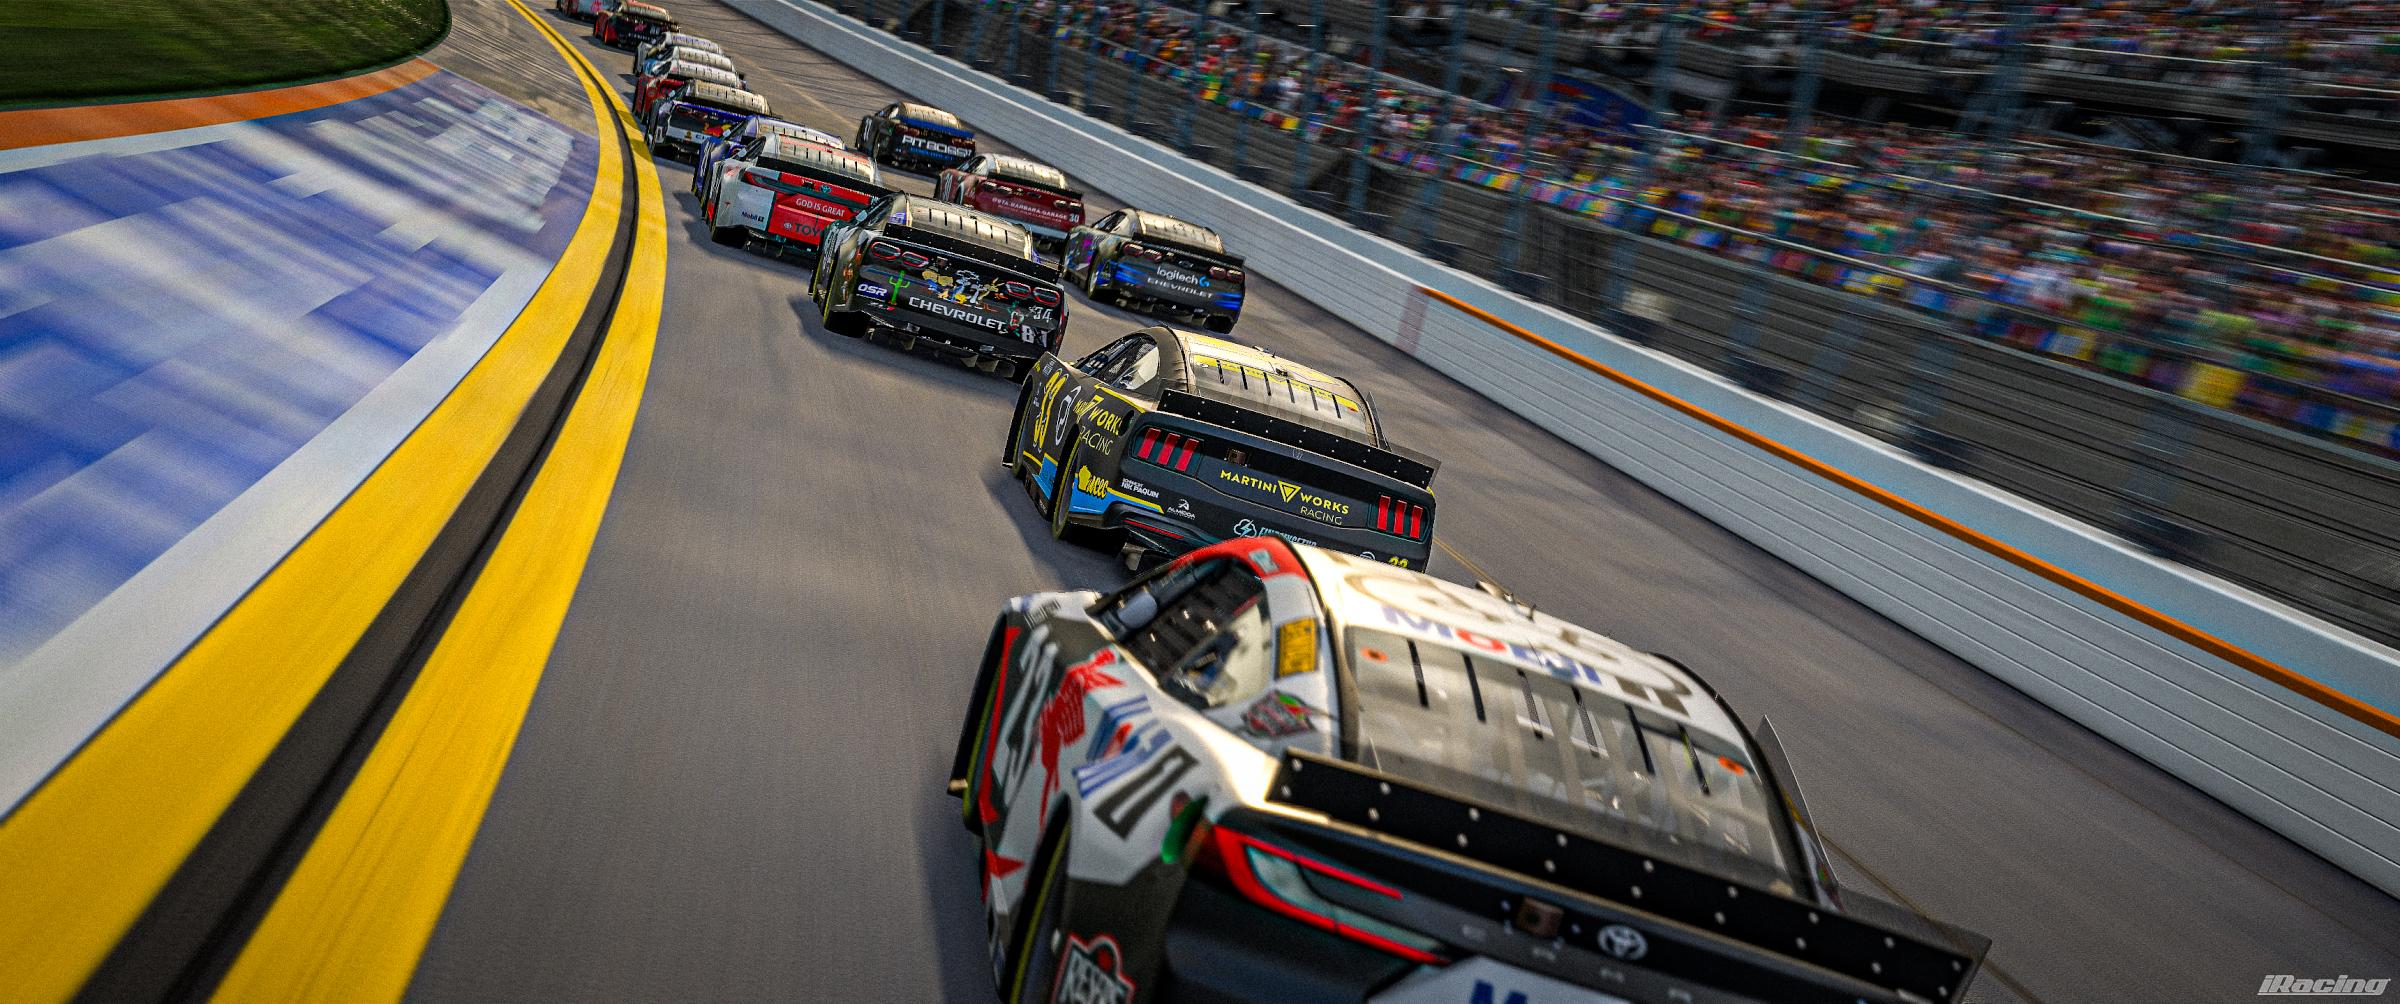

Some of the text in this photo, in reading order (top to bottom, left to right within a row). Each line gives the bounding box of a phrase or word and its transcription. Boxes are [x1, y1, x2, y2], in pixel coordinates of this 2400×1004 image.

[901, 135, 926, 147] PIT
[926, 141, 968, 158] BOSS
[742, 211, 758, 222] Mobil
[796, 198, 846, 217] GOD IS GREAT
[1069, 213, 1080, 223] 30
[1157, 265, 1198, 286] logitech
[858, 283, 887, 297] OSR
[1147, 277, 1214, 299] CHEVROLET
[908, 295, 1007, 332] CHEVROLET
[1034, 306, 1054, 323] 34
[1121, 482, 1160, 499] NIK PAQUIN
[1220, 470, 1350, 515] MARTINI WORKS
[1300, 505, 1343, 526] RACING
